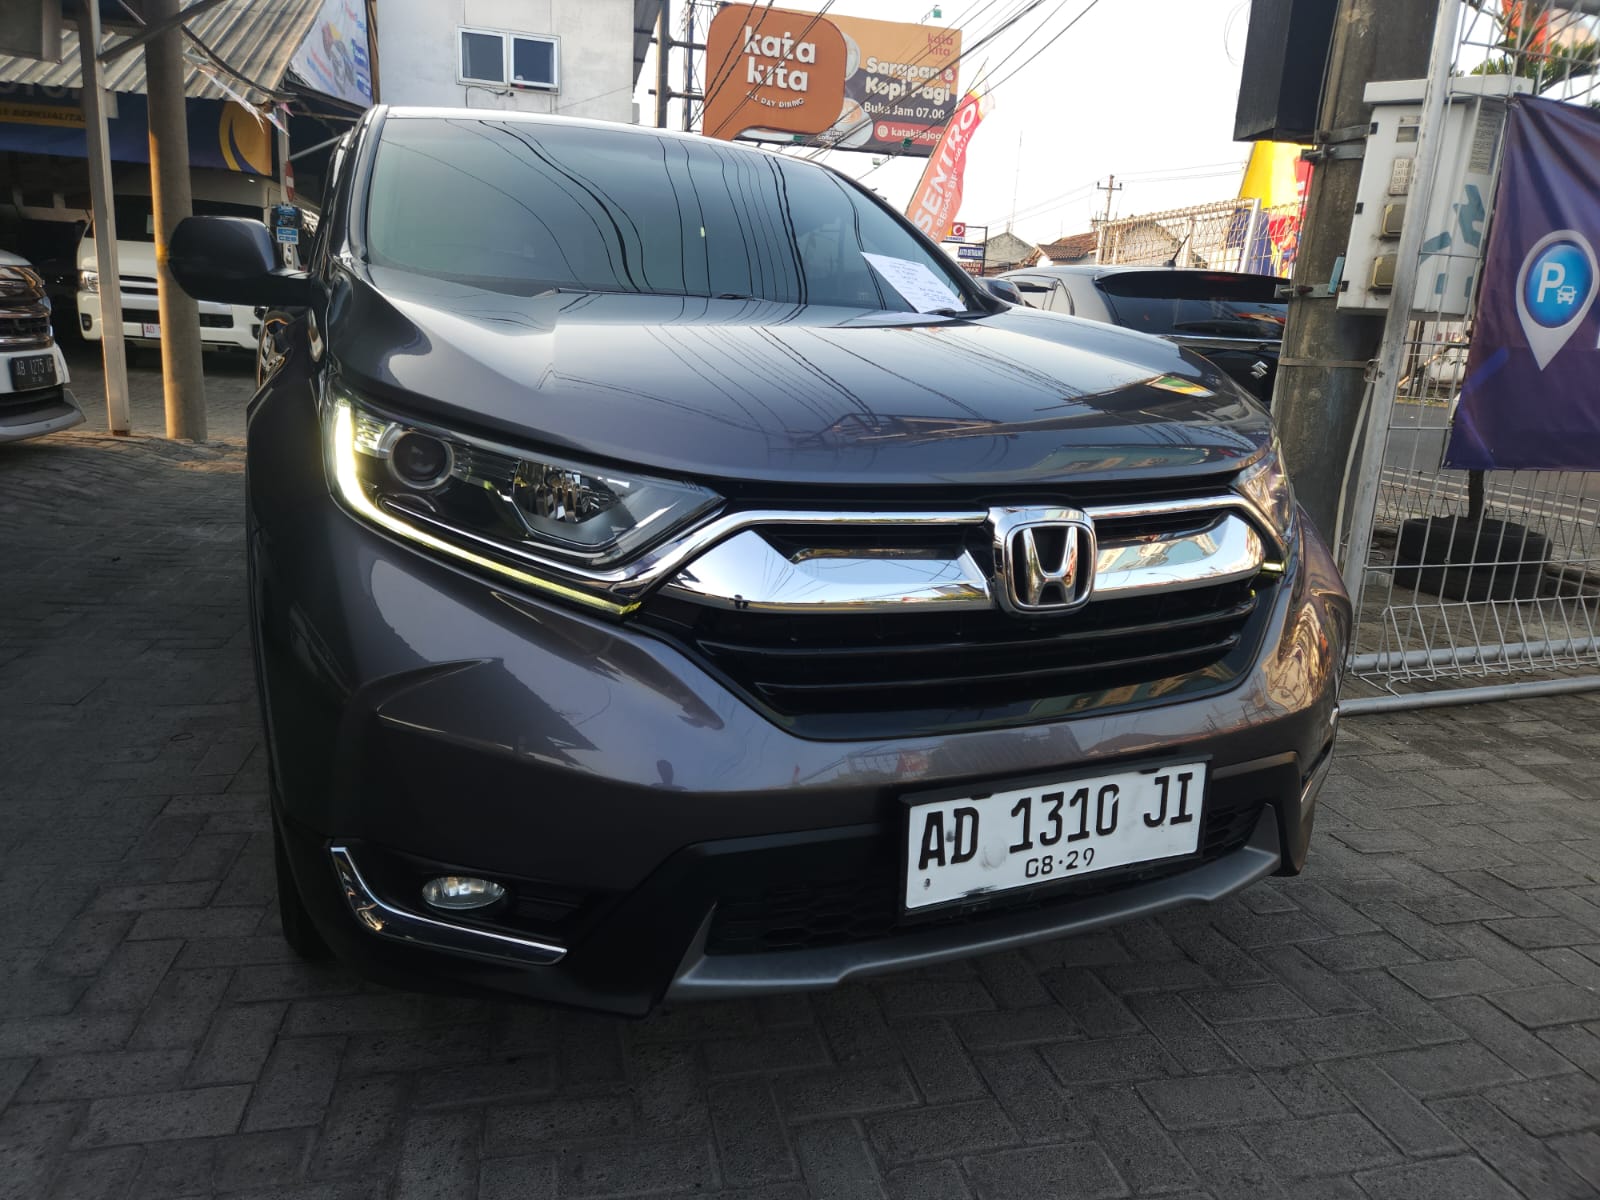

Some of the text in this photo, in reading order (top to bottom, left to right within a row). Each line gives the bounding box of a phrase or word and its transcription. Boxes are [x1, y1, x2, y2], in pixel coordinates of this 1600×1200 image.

[744, 25, 816, 64] kata
[927, 32, 953, 46] kata
[746, 56, 808, 92] kita
[866, 56, 940, 82] Sarapan
[761, 97, 776, 107] DAY
[865, 76, 951, 106] Kopi Pagi
[864, 101, 945, 119] Buka Jam 07.00
[914, 103, 977, 233] SENTRO
[918, 772, 1193, 871] AD 1310 JI
